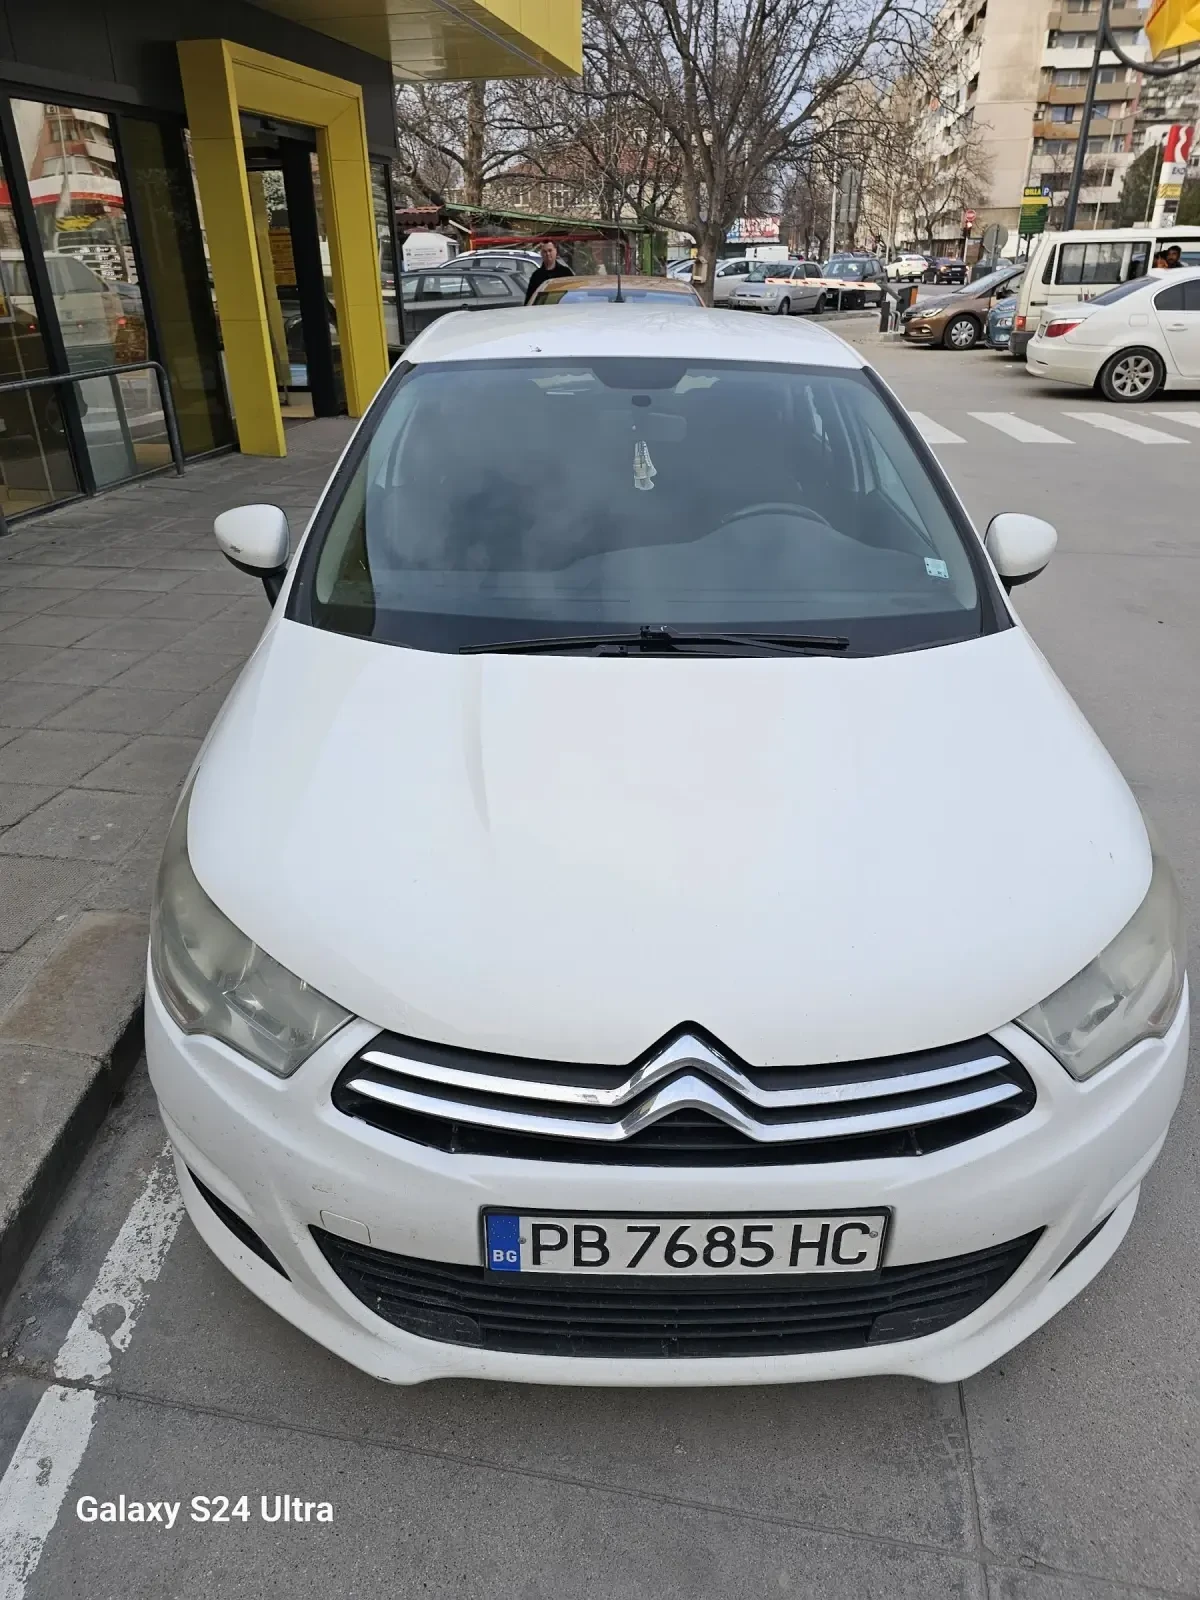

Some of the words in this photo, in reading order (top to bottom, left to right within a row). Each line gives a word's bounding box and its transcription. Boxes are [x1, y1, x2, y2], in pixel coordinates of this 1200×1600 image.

[492, 1250, 517, 1263] BG
[532, 1223, 610, 1267] PB
[626, 1225, 775, 1268] 7685
[789, 1222, 870, 1266] HC
